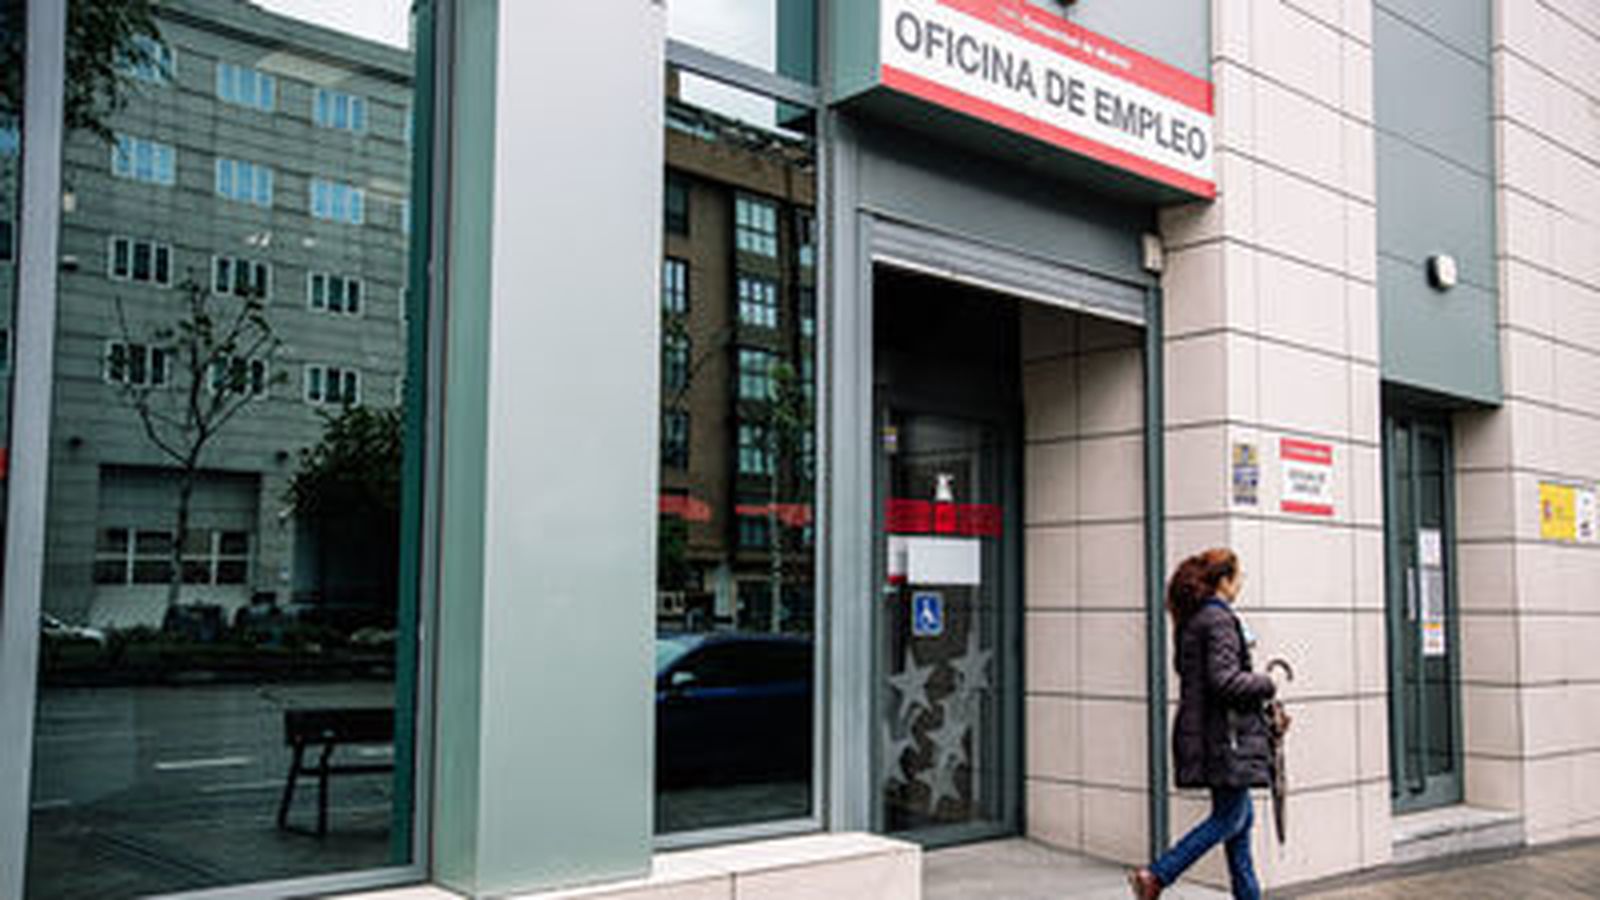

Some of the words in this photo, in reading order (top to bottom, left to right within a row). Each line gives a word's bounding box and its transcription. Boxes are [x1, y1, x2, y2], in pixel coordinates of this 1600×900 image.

[895, 12, 1036, 97] OFICINA
[1045, 71, 1086, 116] DE
[1094, 89, 1207, 160] EMPLEO
